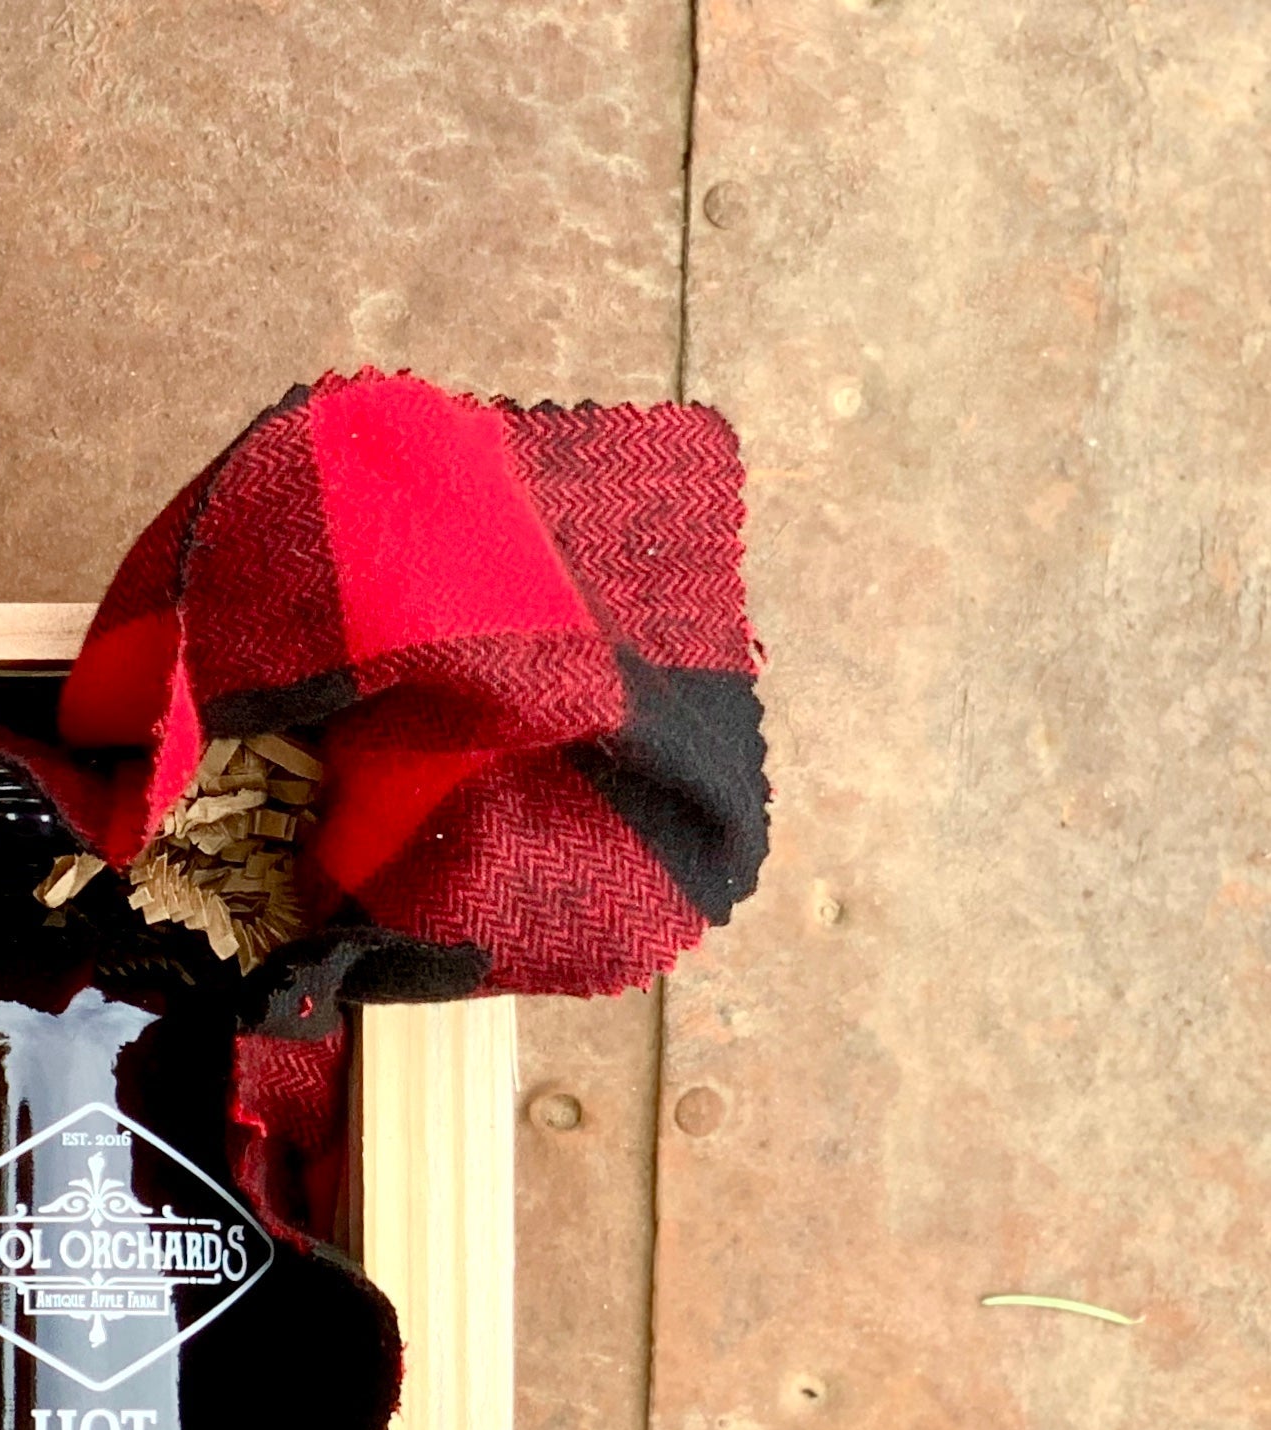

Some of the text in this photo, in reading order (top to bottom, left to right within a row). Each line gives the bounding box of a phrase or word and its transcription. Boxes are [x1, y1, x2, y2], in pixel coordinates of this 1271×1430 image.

[62, 1131, 131, 1146] EST. 2016
[60, 1225, 247, 1282] ORCHARDS
[36, 1291, 86, 1308] ANTIQUE
[127, 1292, 157, 1309] FARM
